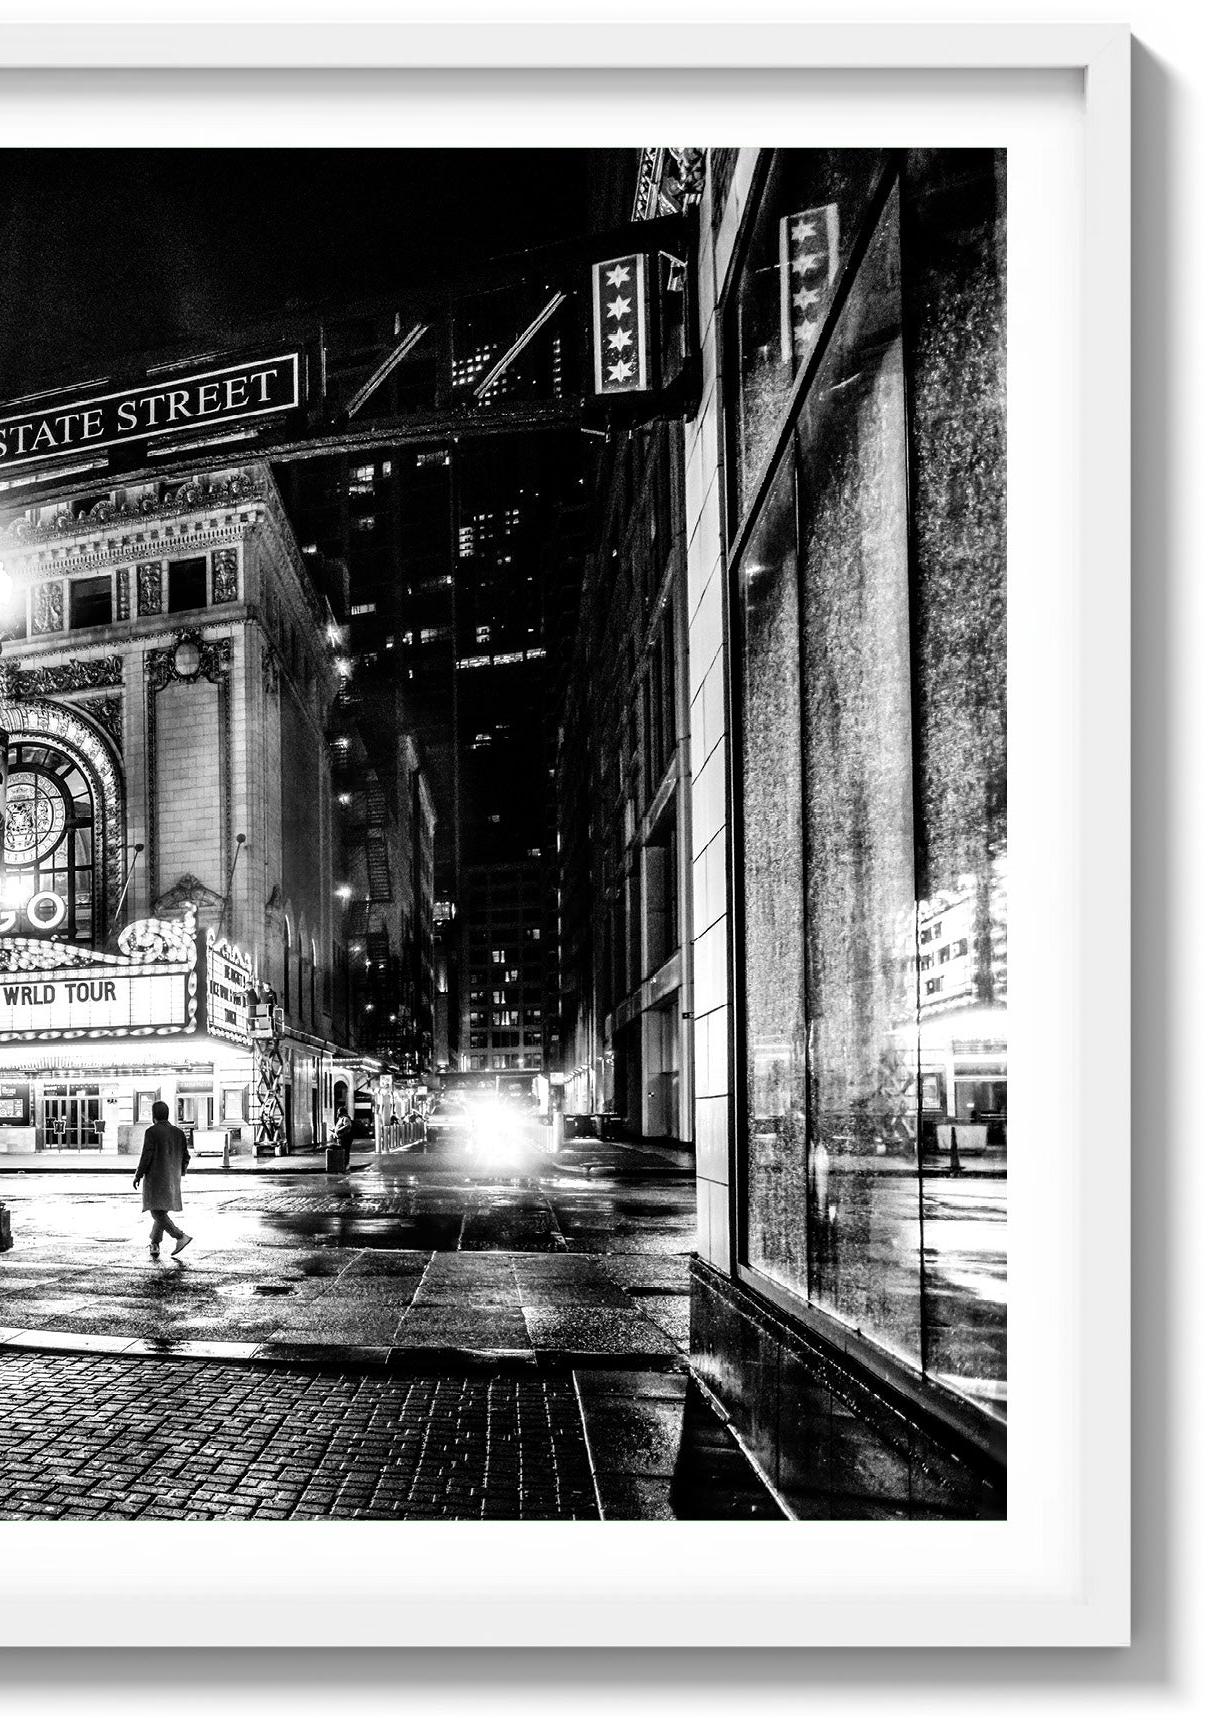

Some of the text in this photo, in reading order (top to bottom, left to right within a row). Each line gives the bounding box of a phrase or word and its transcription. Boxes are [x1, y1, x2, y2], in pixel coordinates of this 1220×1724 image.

[117, 369, 278, 432] STREET
[3, 984, 55, 1006] WRLD
[64, 981, 116, 1004] TOUR
